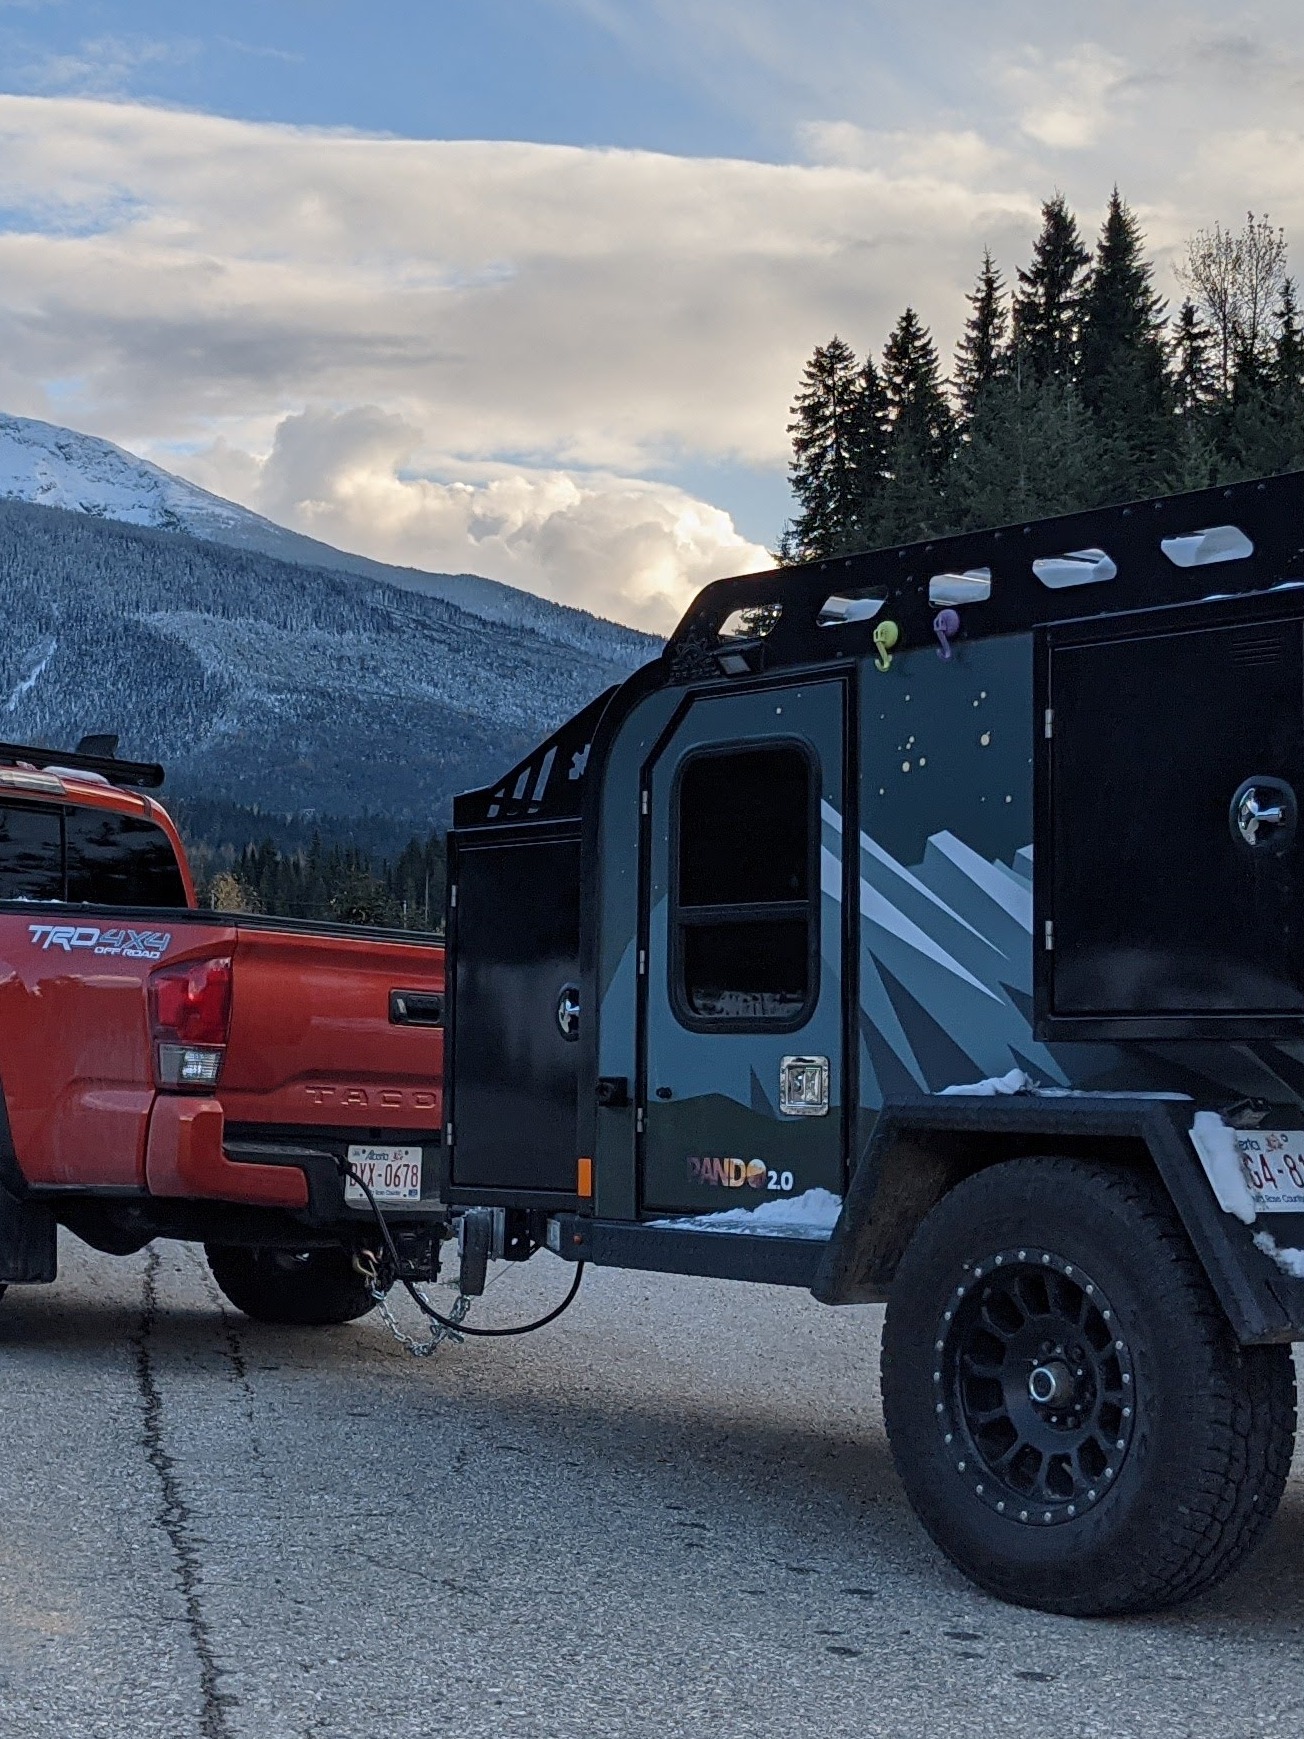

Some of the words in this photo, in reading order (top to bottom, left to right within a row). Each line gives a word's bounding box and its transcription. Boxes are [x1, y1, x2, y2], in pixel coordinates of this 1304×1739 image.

[28, 925, 100, 951] TRD
[94, 946, 121, 955] OFF
[121, 948, 161, 959] ROAD
[304, 1085, 437, 1109] TACO
[687, 1156, 767, 1189] PANDO
